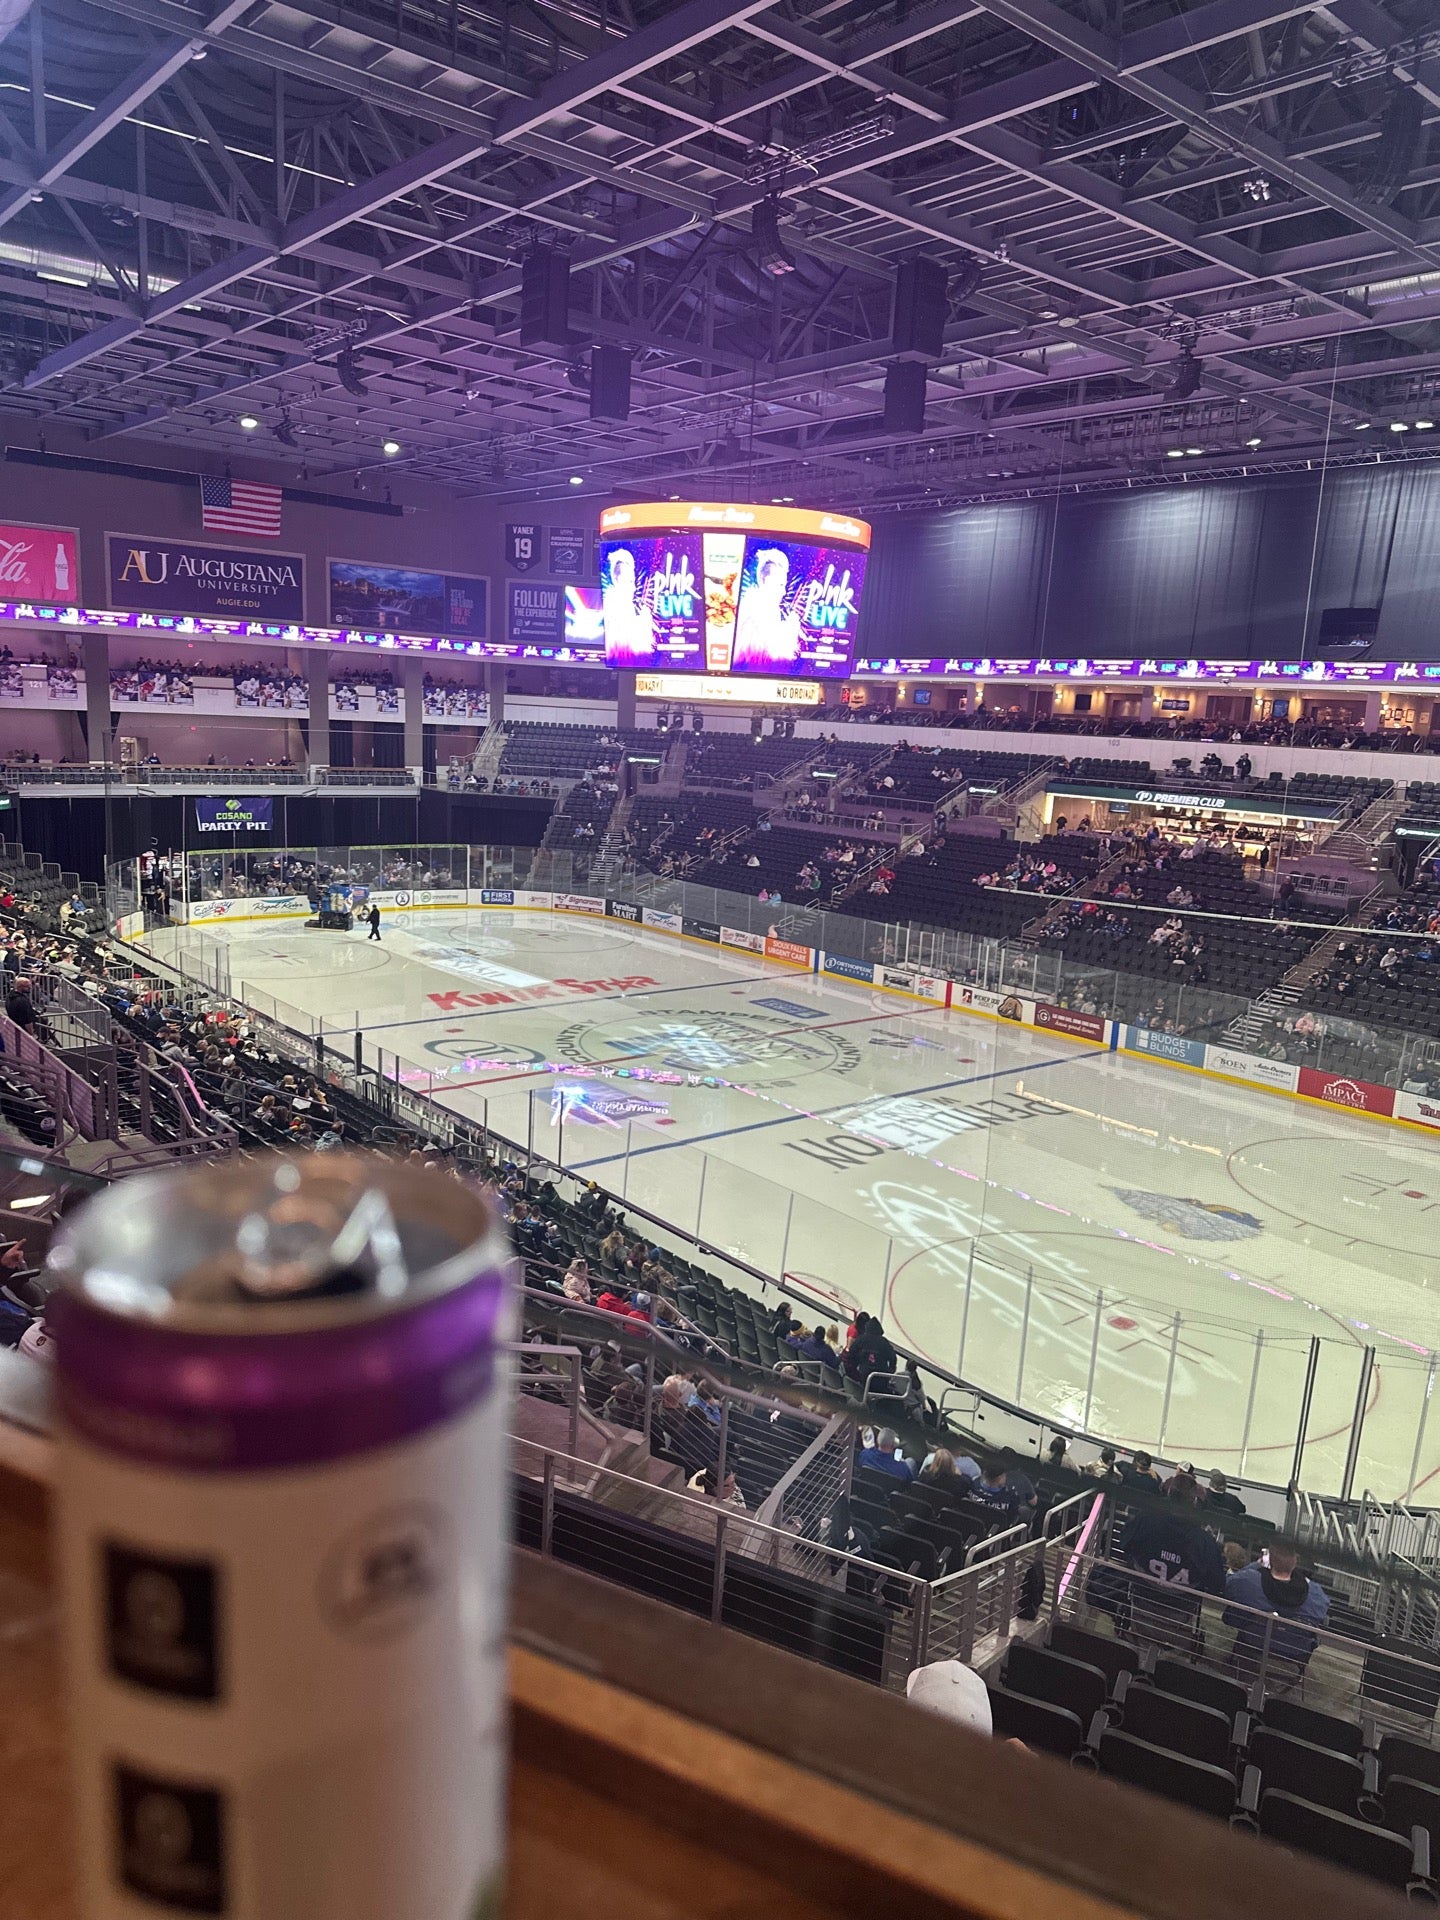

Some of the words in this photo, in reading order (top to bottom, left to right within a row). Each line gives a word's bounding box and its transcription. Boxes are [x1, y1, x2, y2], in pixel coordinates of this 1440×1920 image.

[512, 526, 534, 534] VANEK
[514, 537, 532, 558] 19
[173, 555, 299, 587] AUGUSTANA
[197, 578, 278, 596] UNIVERSITY
[216, 597, 261, 609] AUGIE.EDU
[513, 589, 558, 609] FOLLOW
[659, 593, 693, 618] LIVE
[513, 607, 525, 617] THE
[525, 609, 558, 619] EXPERIENCE
[811, 605, 848, 629] LIVE
[1107, 739, 1121, 747] 103
[1153, 793, 1201, 807] PREMIER
[1200, 797, 1226, 808] CLUB
[215, 812, 253, 820] COSANO
[200, 821, 242, 831] PARTY
[245, 821, 268, 831] PIT
[490, 891, 512, 899] FIRST
[612, 901, 638, 914] Furniture
[613, 909, 638, 921] MART
[767, 946, 790, 958] URGENT
[790, 951, 807, 962] CARE
[772, 940, 790, 950] SIOUX
[790, 943, 807, 955] FALLS
[836, 959, 874, 974] ORTHOPEDIC
[554, 1018, 602, 1063] COUNTRY
[1150, 1032, 1193, 1049] BUDGET
[812, 1029, 863, 1076] COUNTRY
[1150, 1041, 1186, 1058] BLINDS
[1220, 1058, 1248, 1070] BOEN
[1321, 1094, 1366, 1110] CONSTRUCTION
[1323, 1085, 1365, 1104] IMPACT
[1160, 1549, 1182, 1565] HURD
[1148, 1558, 1190, 1586] 94
